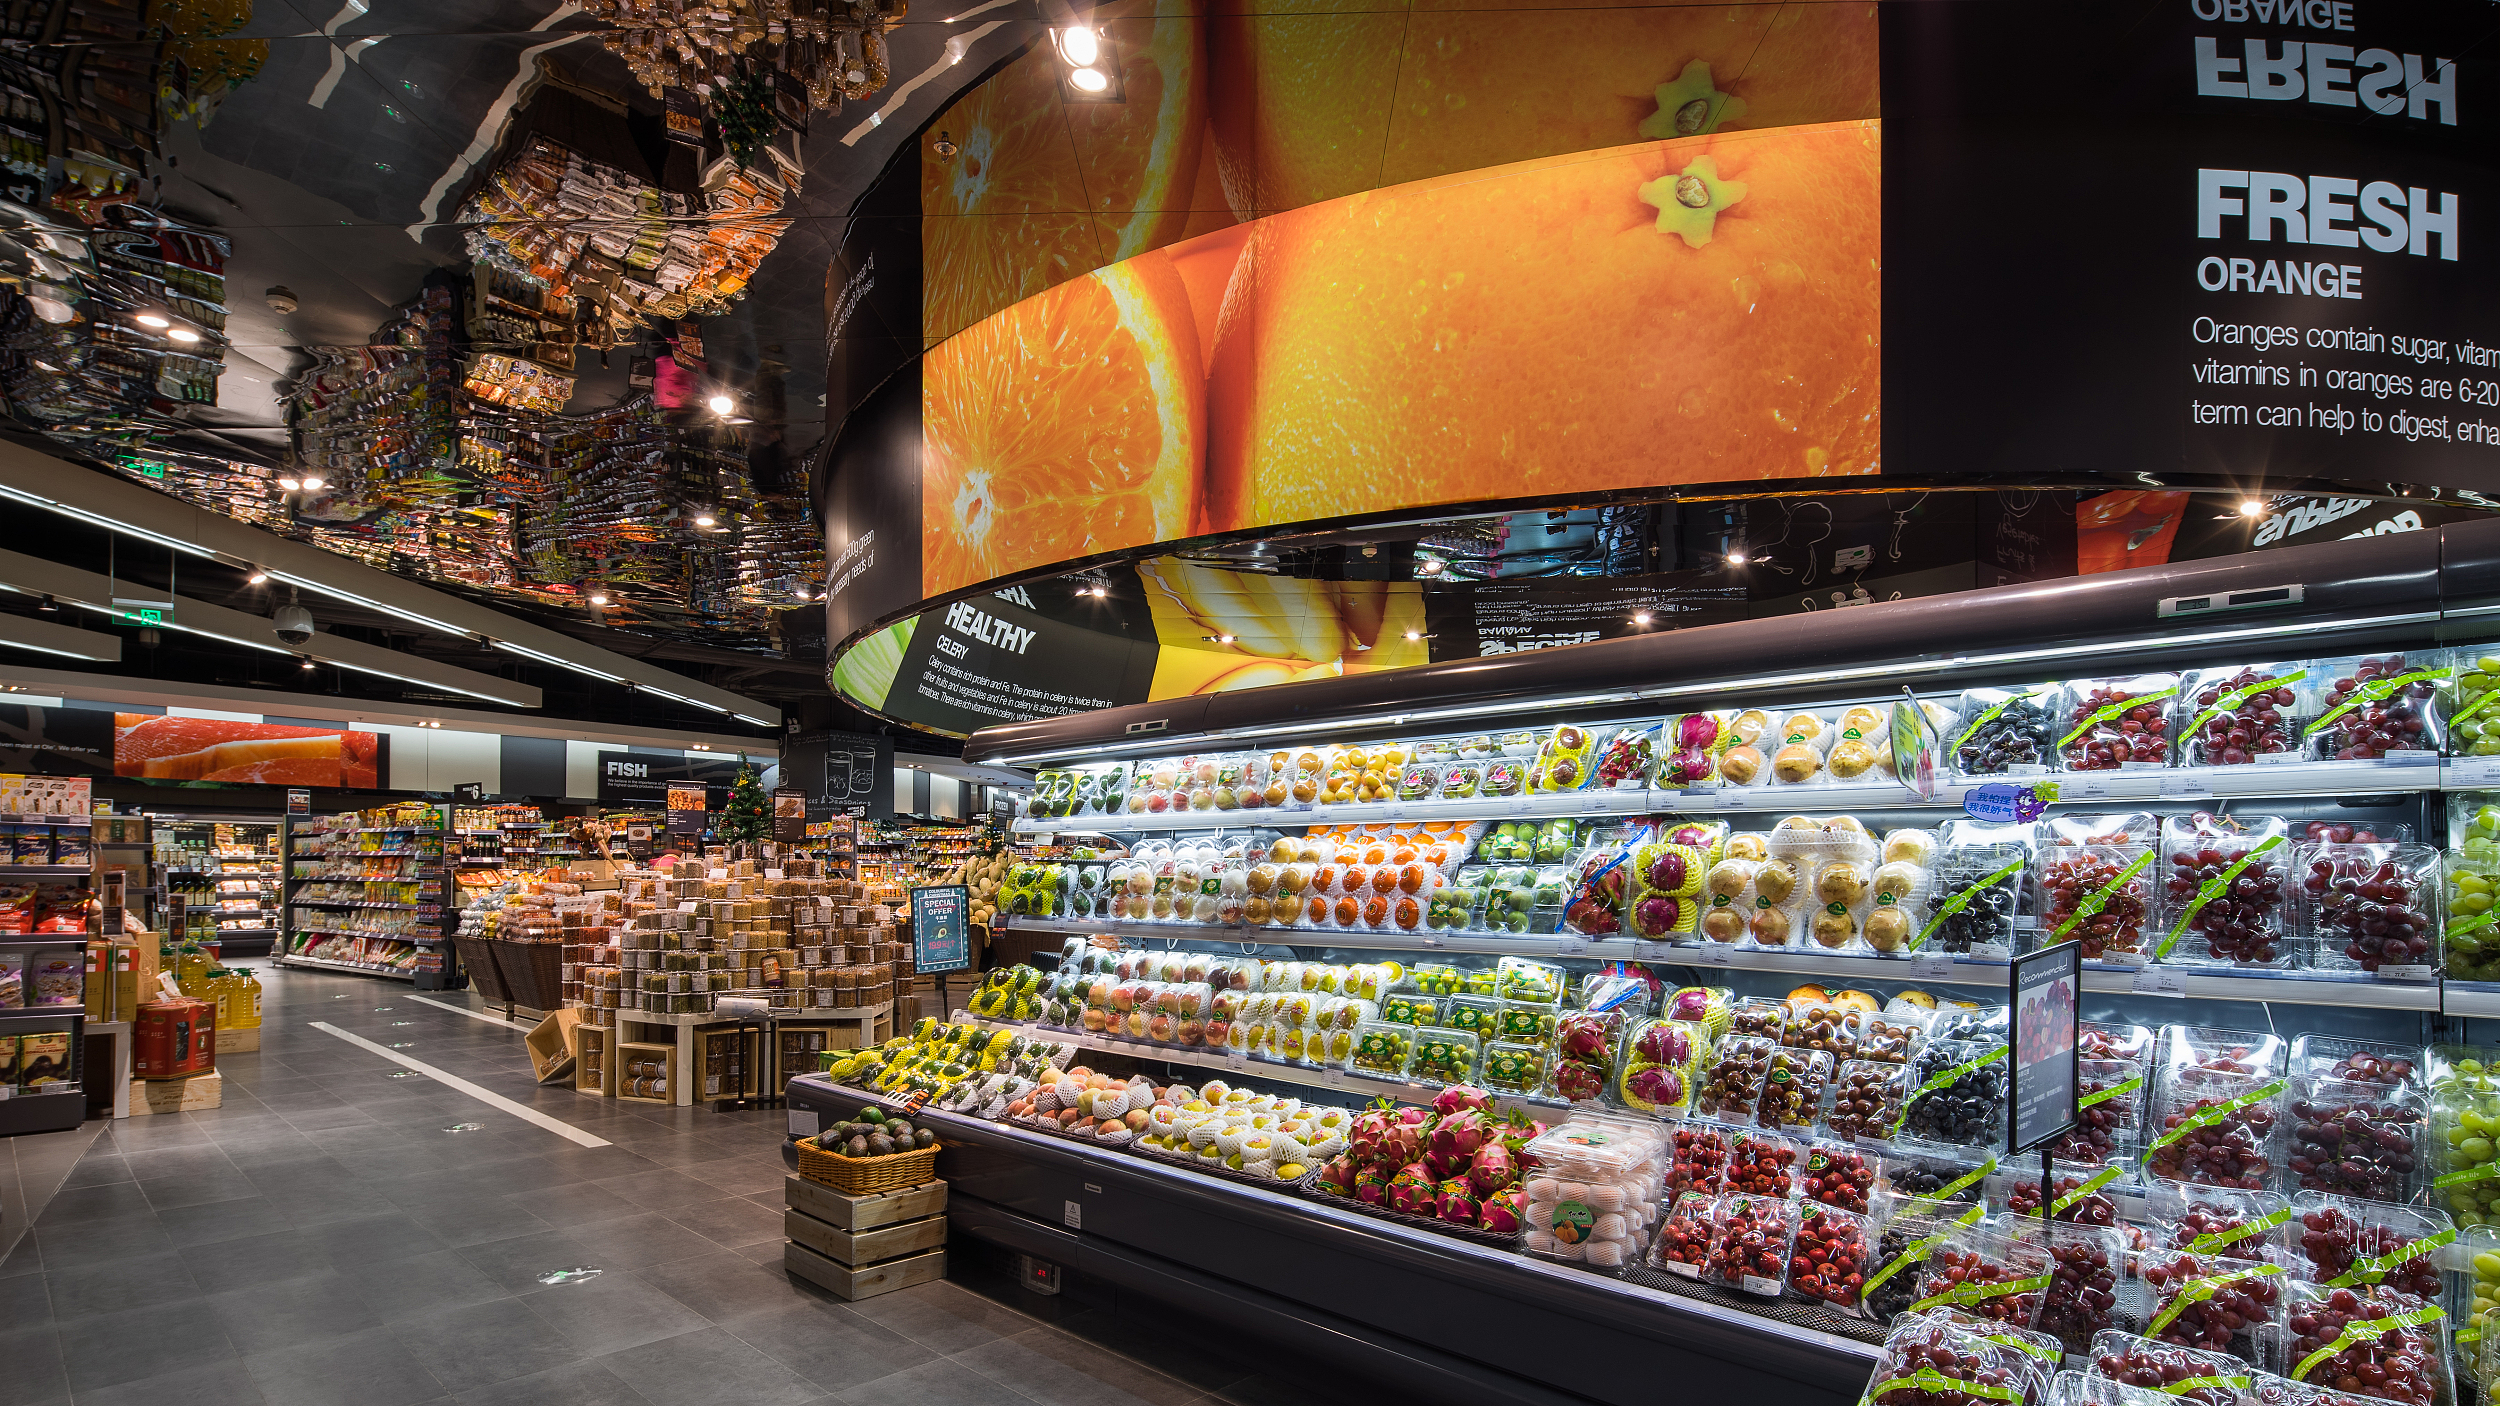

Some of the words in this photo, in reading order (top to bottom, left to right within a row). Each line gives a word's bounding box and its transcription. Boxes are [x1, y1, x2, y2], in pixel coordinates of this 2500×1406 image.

[2198, 168, 2458, 261] FRESH
[2198, 256, 2362, 299] ORANGE
[2193, 316, 2298, 351] Oranges
[2306, 325, 2385, 354] contain
[2391, 334, 2450, 364] sugar,
[2193, 357, 2290, 387] vitamins
[2300, 361, 2317, 388] in
[2326, 366, 2413, 399] oranges
[2420, 376, 2452, 400] are
[2459, 378, 2500, 407] 6-20
[2192, 399, 2248, 425] term
[2256, 404, 2301, 427] can
[2309, 402, 2355, 436] help
[2362, 406, 2383, 431] to
[2389, 409, 2452, 442] digest,
[859, 529, 875, 554] green
[851, 557, 867, 579] needs
[868, 549, 874, 567] of
[945, 601, 1036, 655] HEALTHY
[936, 634, 969, 660] CELERY
[922, 671, 936, 683] other
[947, 681, 960, 693] and
[960, 685, 987, 700] vegetables
[986, 693, 1000, 704] and
[999, 694, 1008, 705] Fe
[1007, 697, 1015, 707] in
[1014, 700, 1033, 712] celery
[1033, 701, 1039, 711] is
[1039, 703, 1058, 714] about
[1058, 706, 1068, 715] 20
[928, 654, 944, 672] Celery
[943, 664, 963, 679] contains
[989, 680, 1002, 690] and
[1012, 683, 1023, 695] The
[1022, 688, 1043, 699] protein
[1043, 691, 1050, 700] in
[1050, 693, 1068, 705] celery
[1068, 695, 1074, 704] is
[1075, 696, 1090, 706] twice
[1091, 698, 1106, 708] than
[1106, 699, 1113, 708] in
[940, 691, 953, 706] There
[953, 698, 962, 708] are
[998, 708, 1016, 722] celery,
[2477, 699, 2487, 708] life
[607, 761, 648, 777] FISH
[472, 785, 479, 800] 6
[1977, 793, 2012, 806] 我怕捏
[859, 806, 865, 817] 8
[1968, 803, 2013, 818] 我很娇气
[924, 899, 956, 908] SPECIAL
[928, 907, 953, 916] OFFER
[2018, 957, 2068, 985] Recommended
[2438, 1174, 2467, 1185] exquisite
[2195, 1240, 2209, 1250] Fresh
[2208, 1237, 2220, 1245] Fruit
[2187, 1287, 2200, 1297] Fresh
[2305, 1350, 2329, 1367] exquisite
